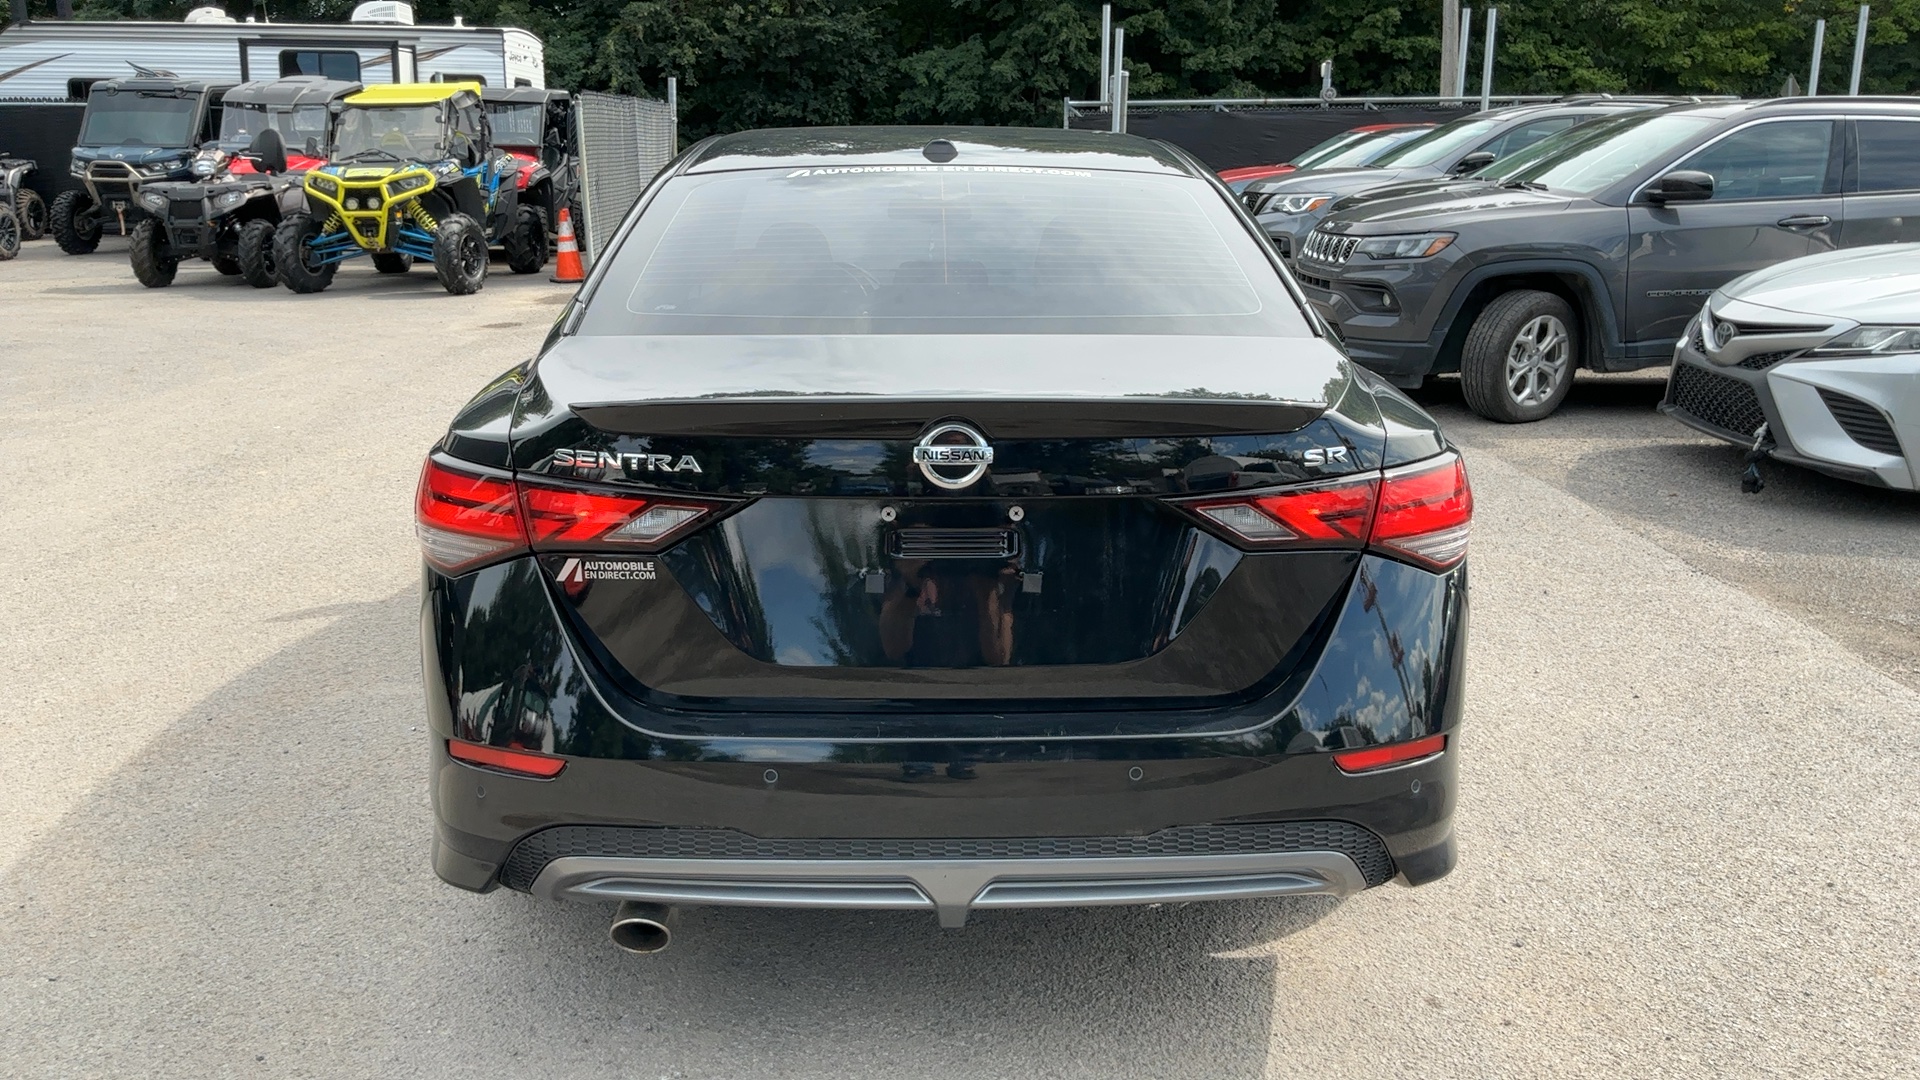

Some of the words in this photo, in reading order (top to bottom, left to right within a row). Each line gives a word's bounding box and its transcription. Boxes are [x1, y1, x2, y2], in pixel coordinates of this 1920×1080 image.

[812, 165, 939, 176] AUTOMOBILE
[973, 165, 1092, 178] DIRECT.COM
[553, 448, 703, 473] SENTRA
[922, 450, 985, 461] NISSAN
[1303, 446, 1348, 467] SR
[584, 561, 655, 571] AUTOMOBILE
[584, 571, 597, 579] EN
[598, 571, 656, 580] DIRECT.COM
